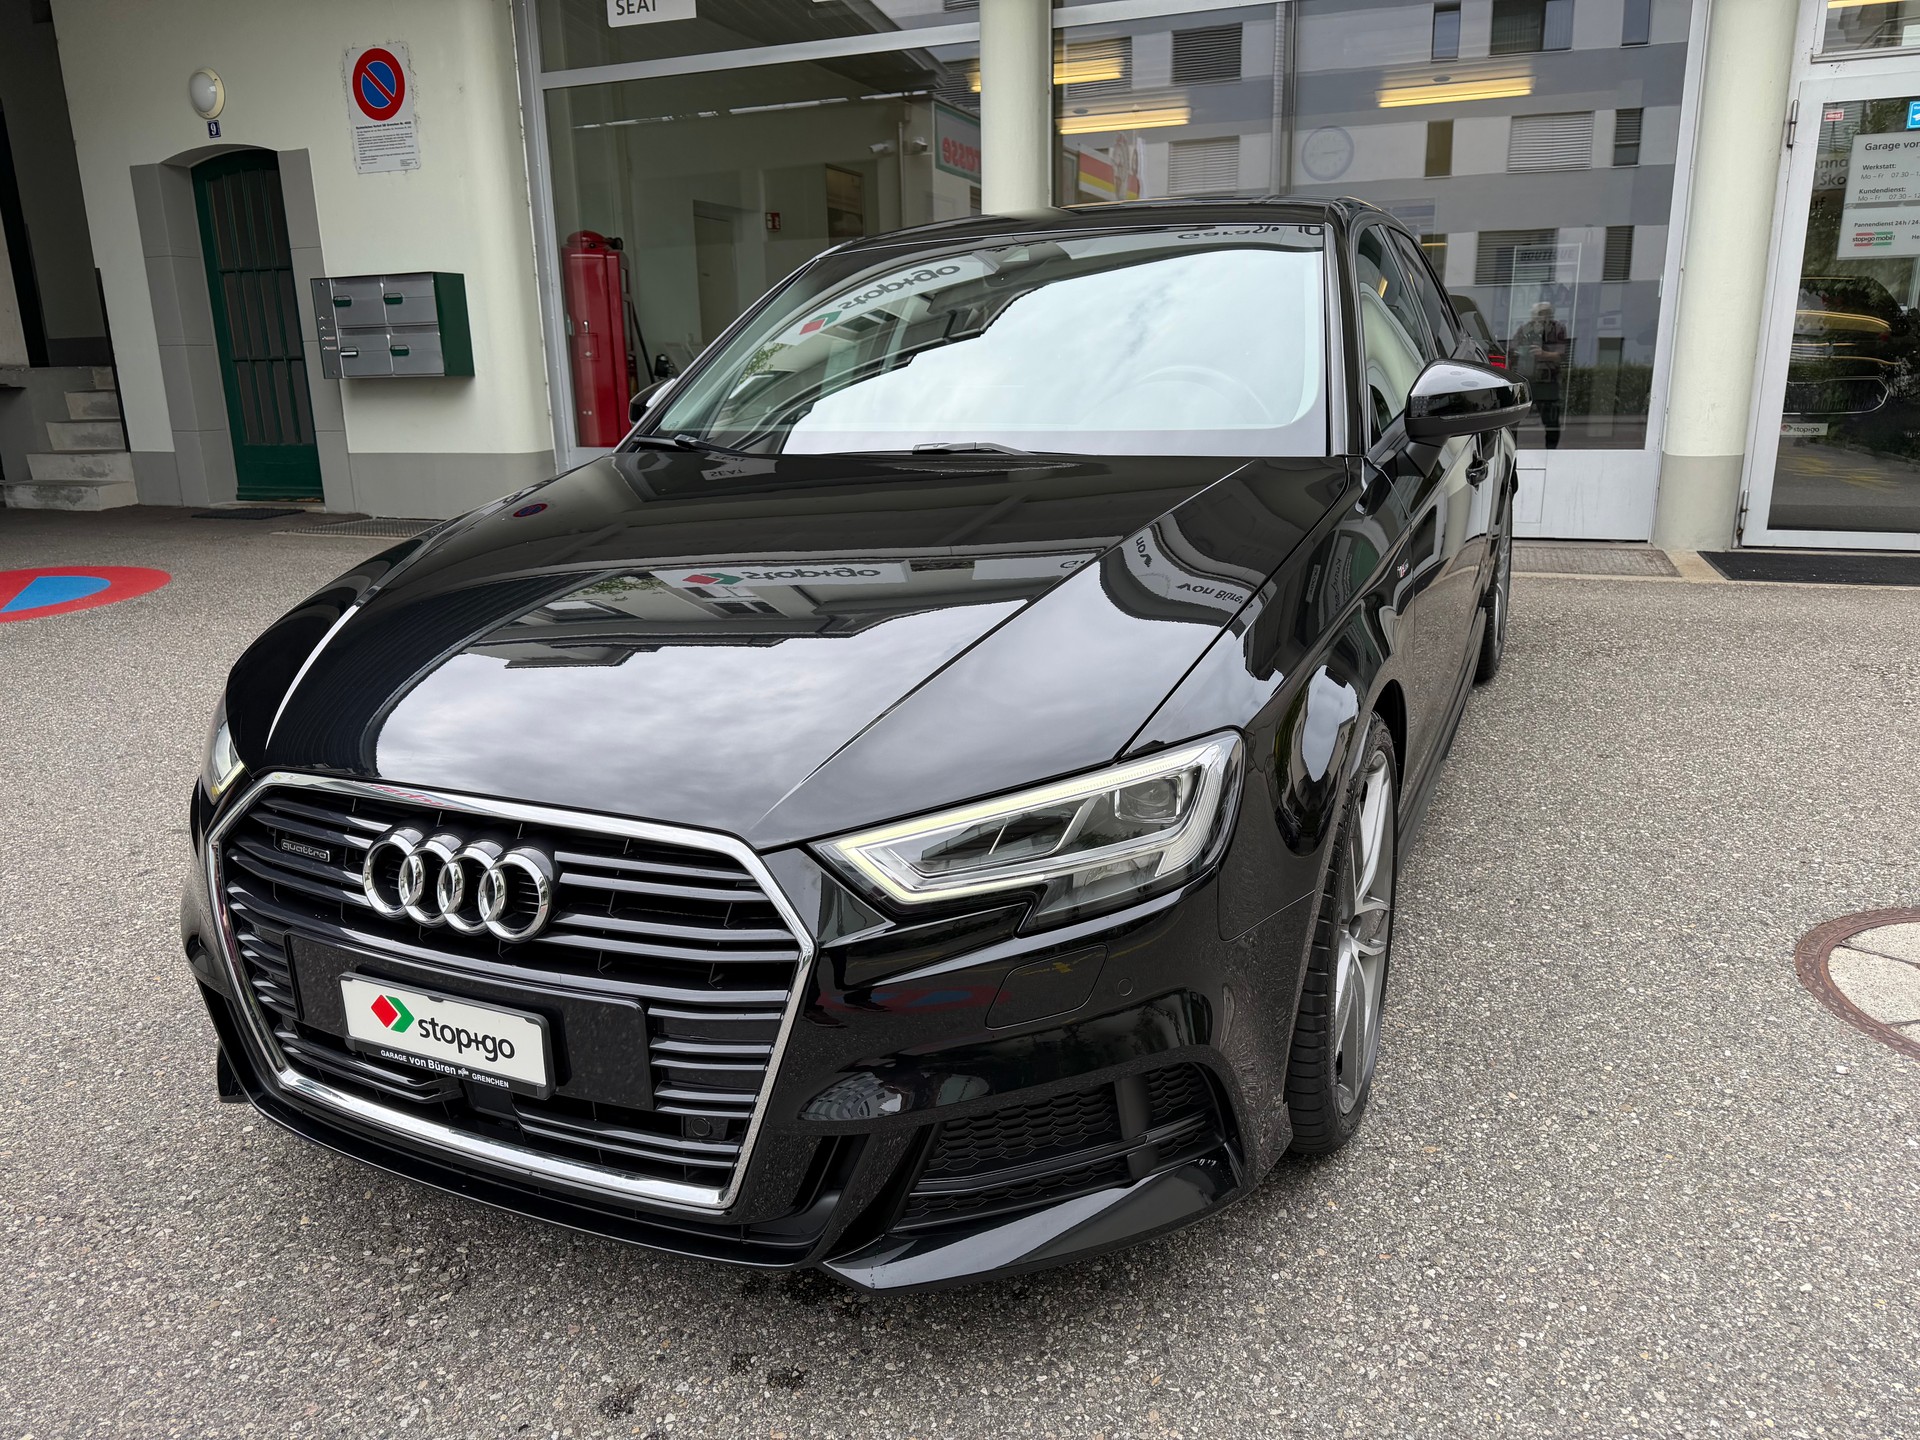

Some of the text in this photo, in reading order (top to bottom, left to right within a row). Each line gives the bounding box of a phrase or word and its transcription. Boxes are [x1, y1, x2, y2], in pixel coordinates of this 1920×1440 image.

[210, 122, 217, 135] 9
[1864, 142, 1900, 152] Garage
[1859, 187, 1906, 195] Kundendienst:
[282, 842, 327, 860] quattro
[418, 1017, 515, 1062] stop+go
[380, 1049, 509, 1088] GARAGE von Büren GRENCHEN
